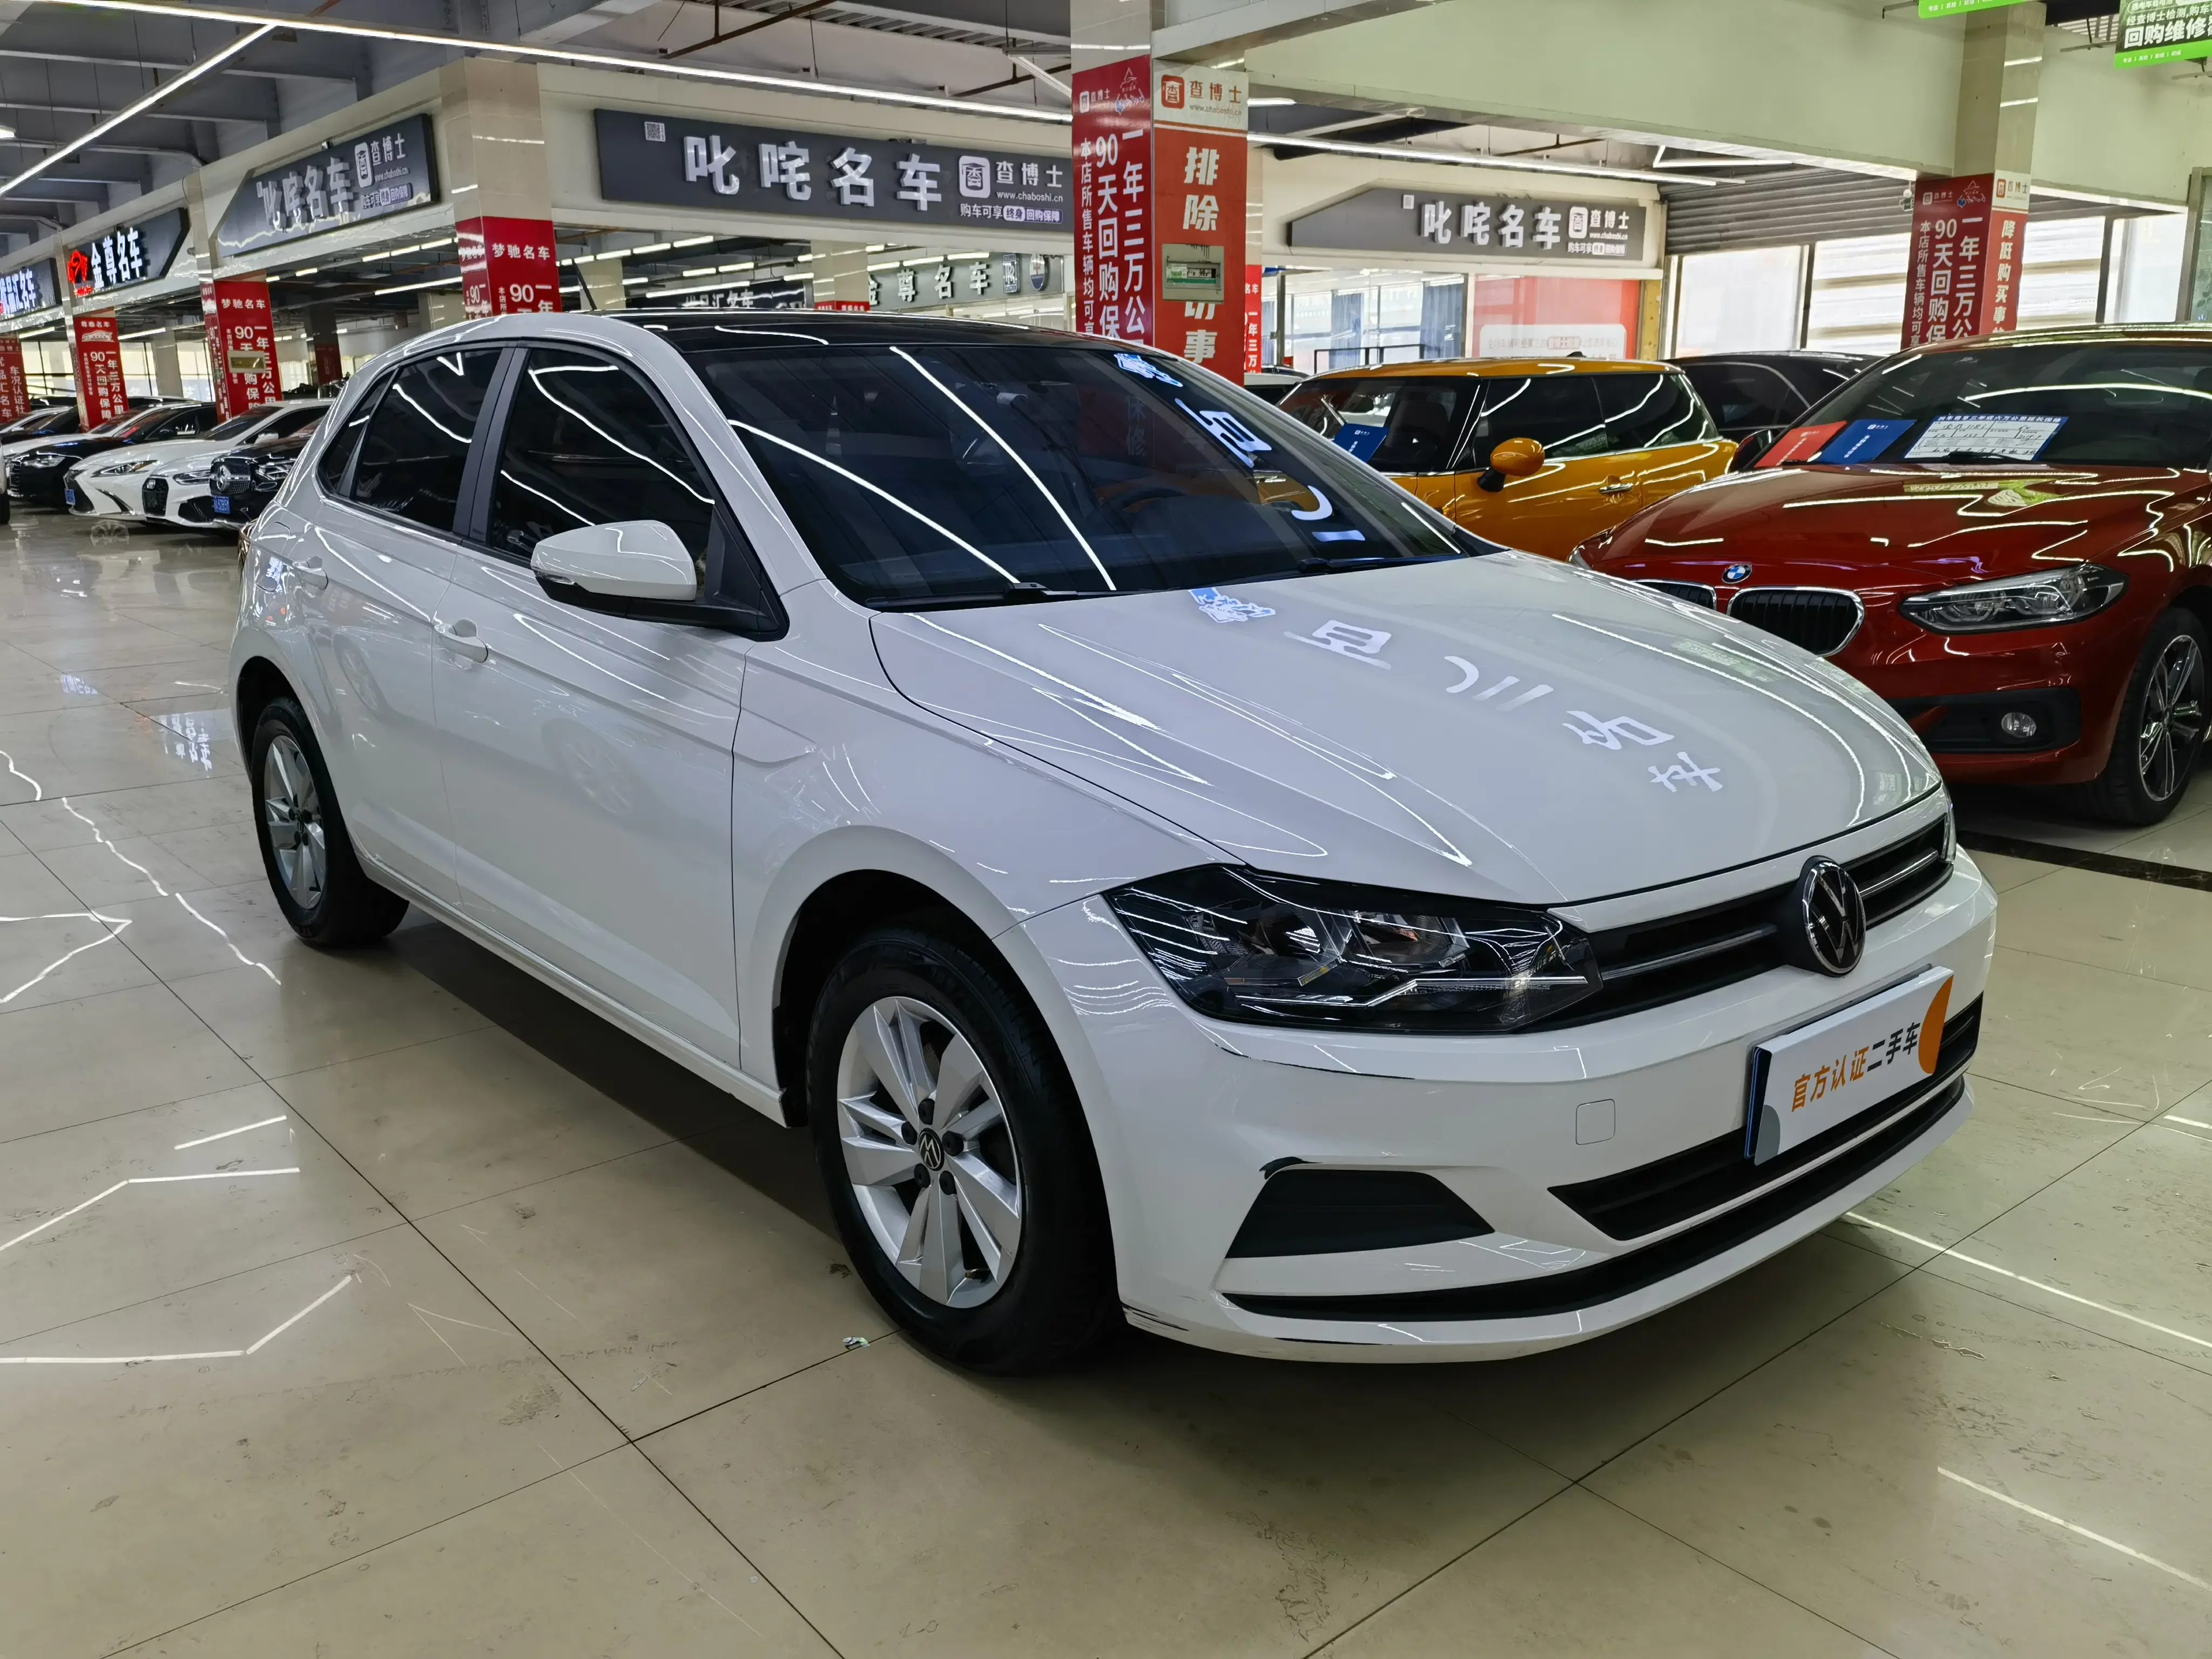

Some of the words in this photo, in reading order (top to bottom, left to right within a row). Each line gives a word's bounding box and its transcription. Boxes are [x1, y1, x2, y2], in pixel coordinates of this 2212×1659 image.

[2126, 4, 2212, 26] 经查博士检测,购车
[1189, 80, 1242, 104] 查博士
[1189, 105, 1242, 116] www.chaboshi.cn
[370, 133, 406, 166] 查博士
[684, 135, 942, 211] 叱咤名车
[995, 161, 1063, 188] 查博士
[996, 191, 1063, 203] www.chaboshi.cn
[1420, 200, 1562, 250] 叱咤名车
[1589, 209, 1629, 230] 查博士
[491, 243, 550, 260] 梦驰名车
[1095, 133, 1121, 339] 90天回购保
[1122, 129, 1145, 346] 一年三万公
[91, 226, 143, 289] 金尊名车
[1183, 146, 1220, 363] 排除事
[1992, 219, 2017, 334] 降低购买事
[221, 298, 266, 309] 梦驰名车
[498, 287, 507, 314] 本店所
[510, 284, 534, 313] 90
[234, 326, 261, 410] 90天购保
[1791, 1022, 1921, 1113] 官方认证二手车
